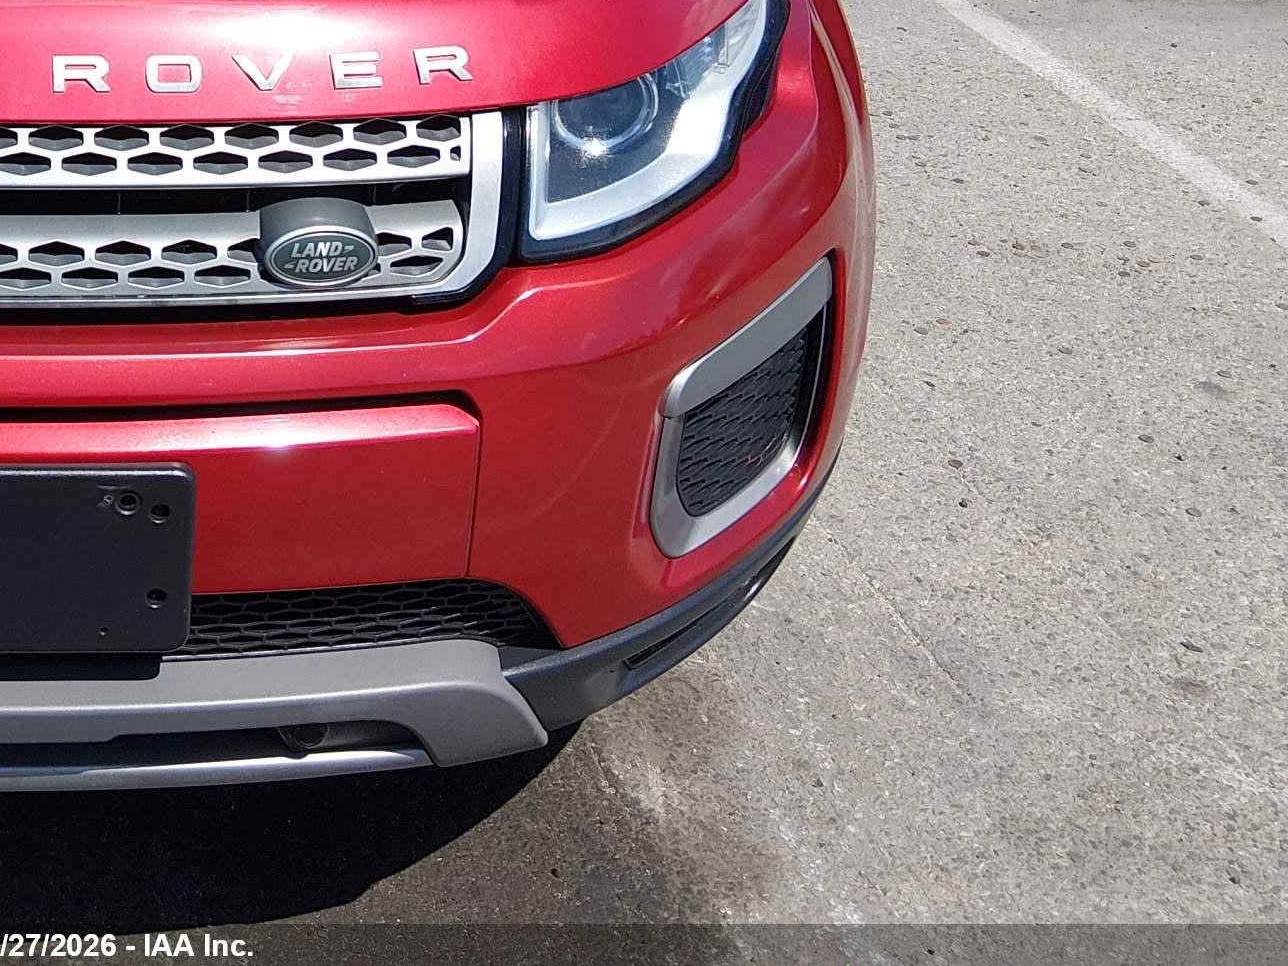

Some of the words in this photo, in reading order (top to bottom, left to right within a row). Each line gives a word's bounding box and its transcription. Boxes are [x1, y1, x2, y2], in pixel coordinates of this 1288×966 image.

[51, 45, 475, 94] ROVER
[291, 240, 343, 259] LAND
[294, 256, 358, 274] ROVER
